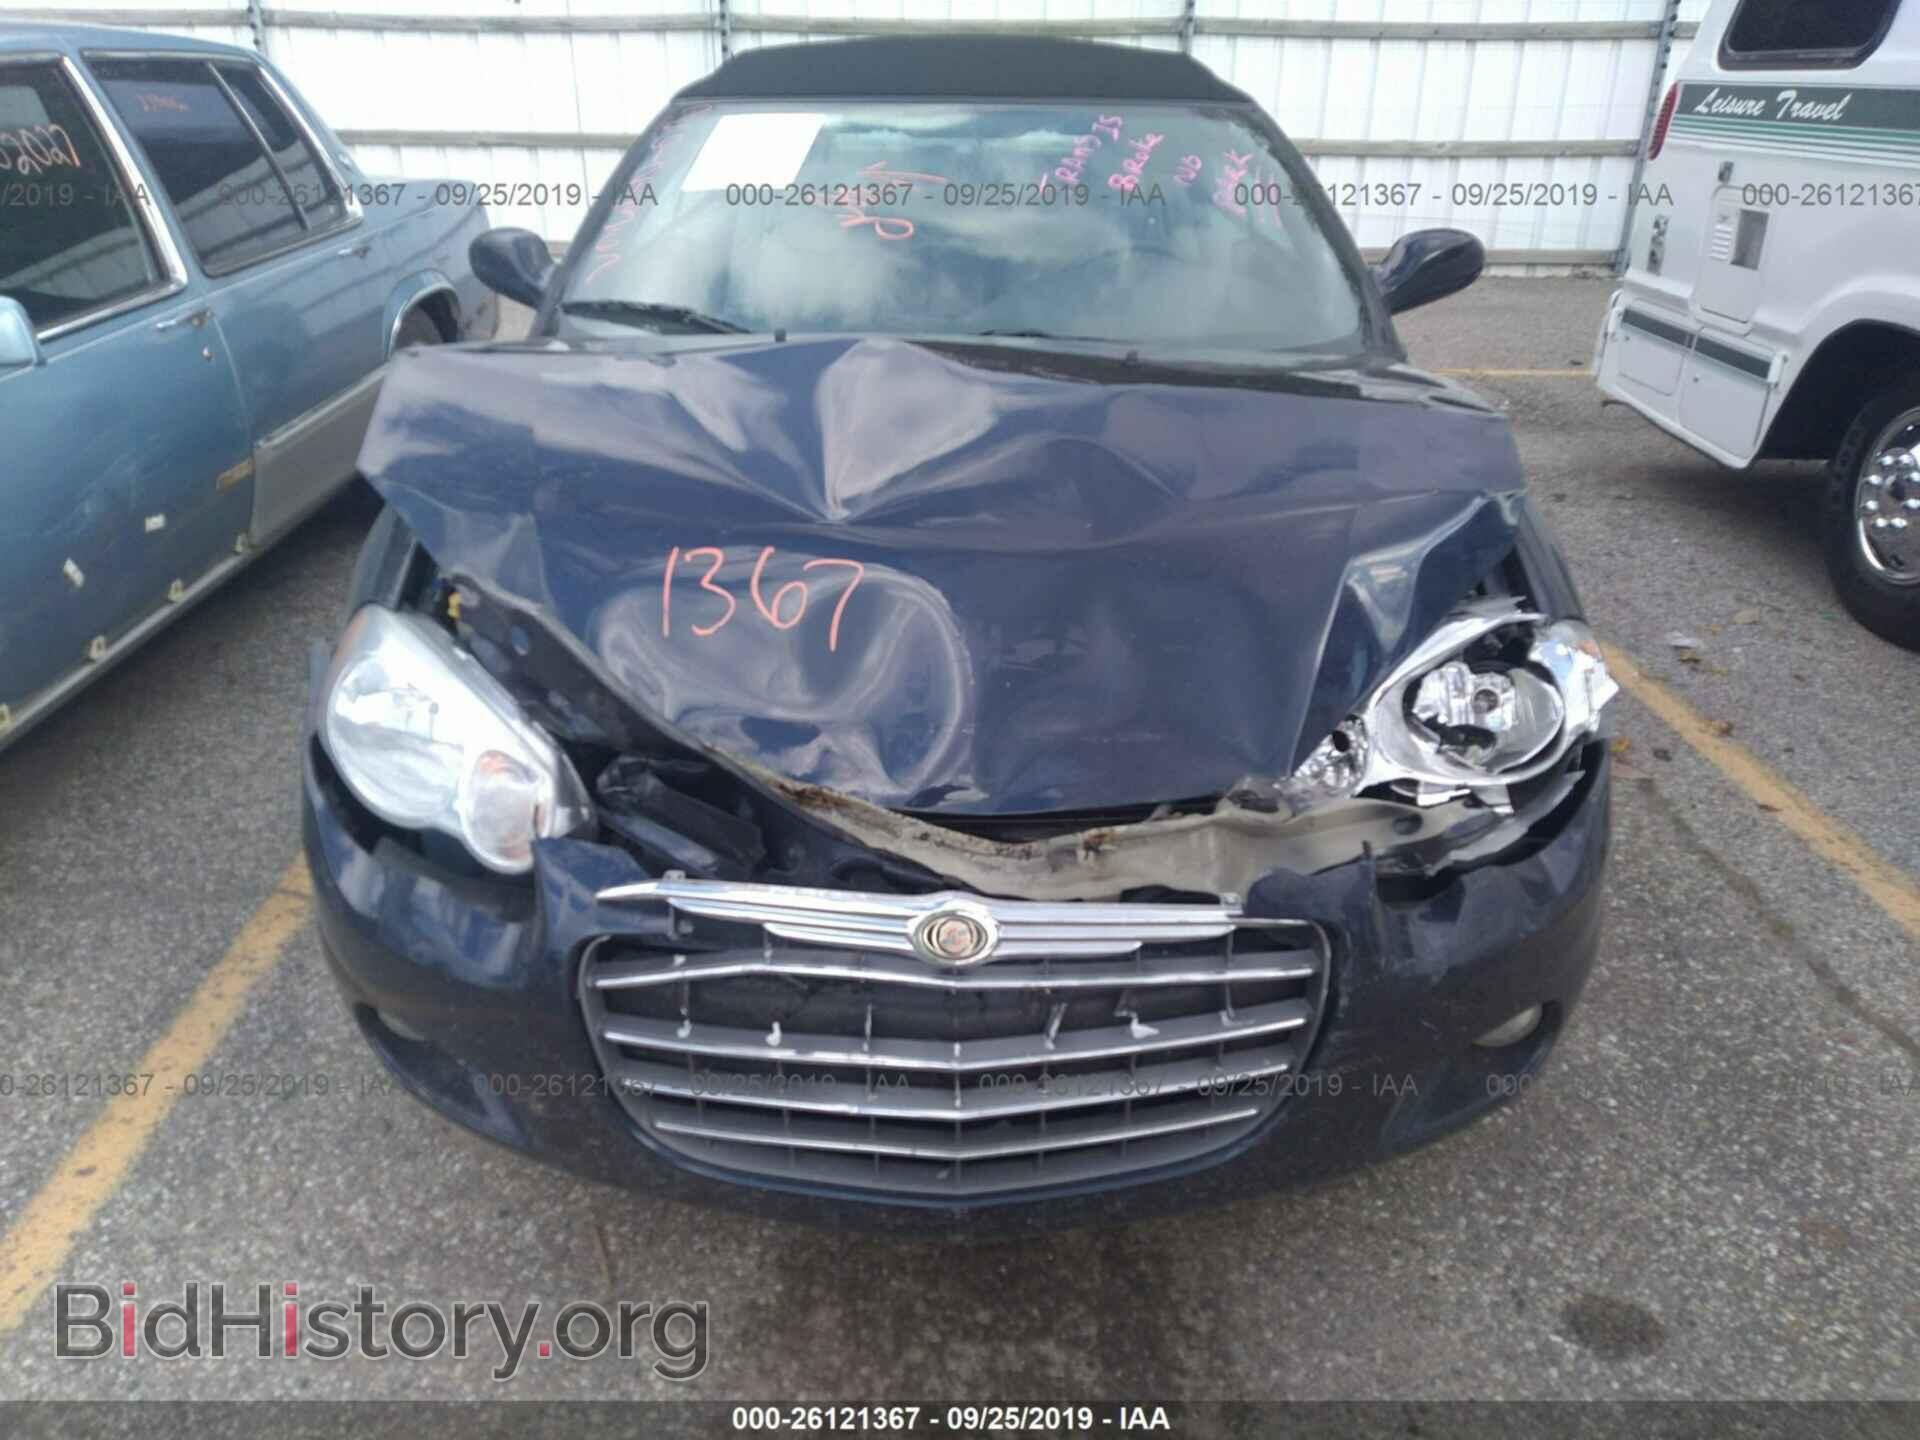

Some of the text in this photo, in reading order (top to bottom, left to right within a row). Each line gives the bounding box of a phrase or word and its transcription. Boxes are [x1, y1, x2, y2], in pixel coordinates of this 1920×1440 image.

[1694, 87, 1852, 121] Leisure Travel
[660, 545, 864, 652] 1367
